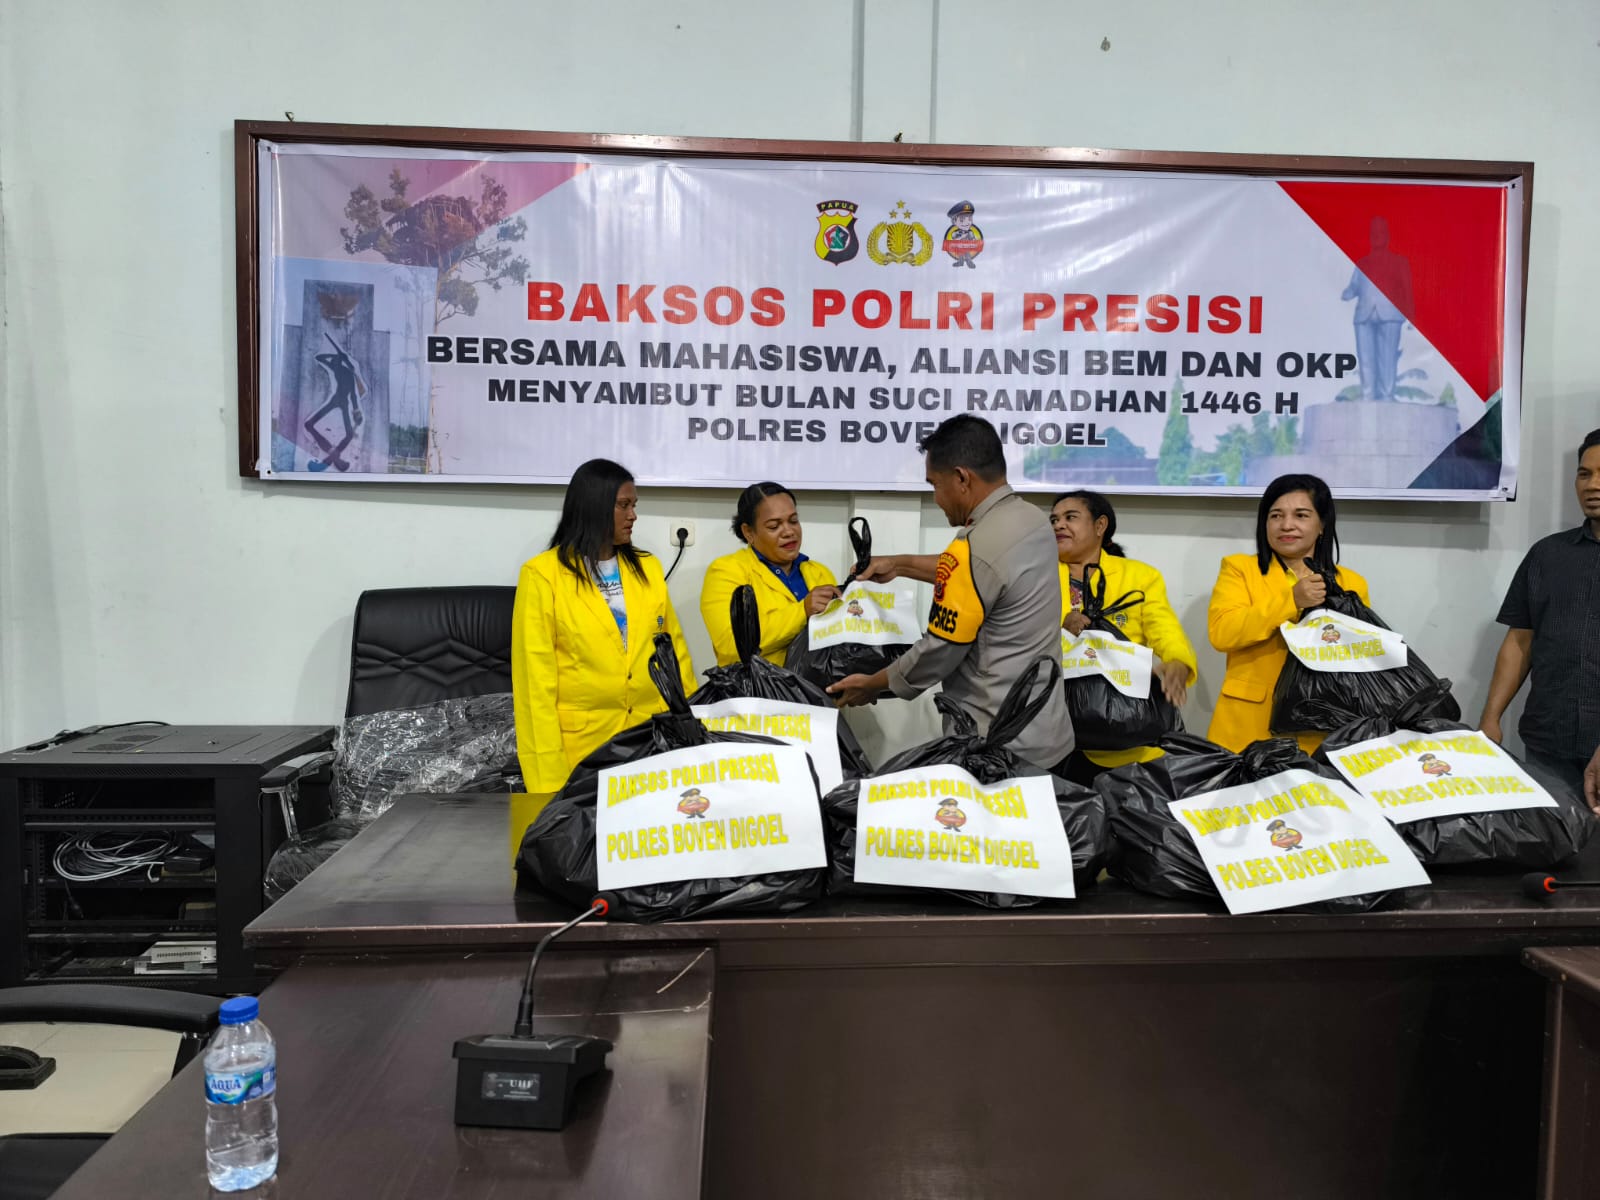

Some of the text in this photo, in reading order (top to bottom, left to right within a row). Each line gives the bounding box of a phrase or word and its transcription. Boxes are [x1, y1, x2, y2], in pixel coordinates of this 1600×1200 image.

[820, 202, 855, 211] PAPUA
[527, 281, 1263, 334] BAKSOS POLRI PRESISI
[427, 336, 1357, 379] BERSAMA MAHASISWA, ALIANSI BEM DAN OKP
[488, 379, 1299, 414] MENYAMBUT BULAN SUCI RAMADHAN 1446 H
[688, 417, 1106, 446] POLRES BOVE IGOEL
[727, 713, 761, 733] POLRI
[763, 713, 812, 743] PRESISI
[1338, 746, 1402, 778] BAKSOS
[607, 752, 780, 808] BAKSOS POLRI PRESISI
[868, 780, 928, 803] BAKSOS
[930, 779, 973, 799] POLRI
[1245, 791, 1296, 823] POLRI
[607, 813, 788, 862] POLRES BOVEN DIGOEL
[866, 826, 1039, 869] POLRES BOVEN DIGOEL
[1216, 838, 1390, 891] POLRES BOVEN DIGOEL
[210, 1078, 242, 1092] AQUA
